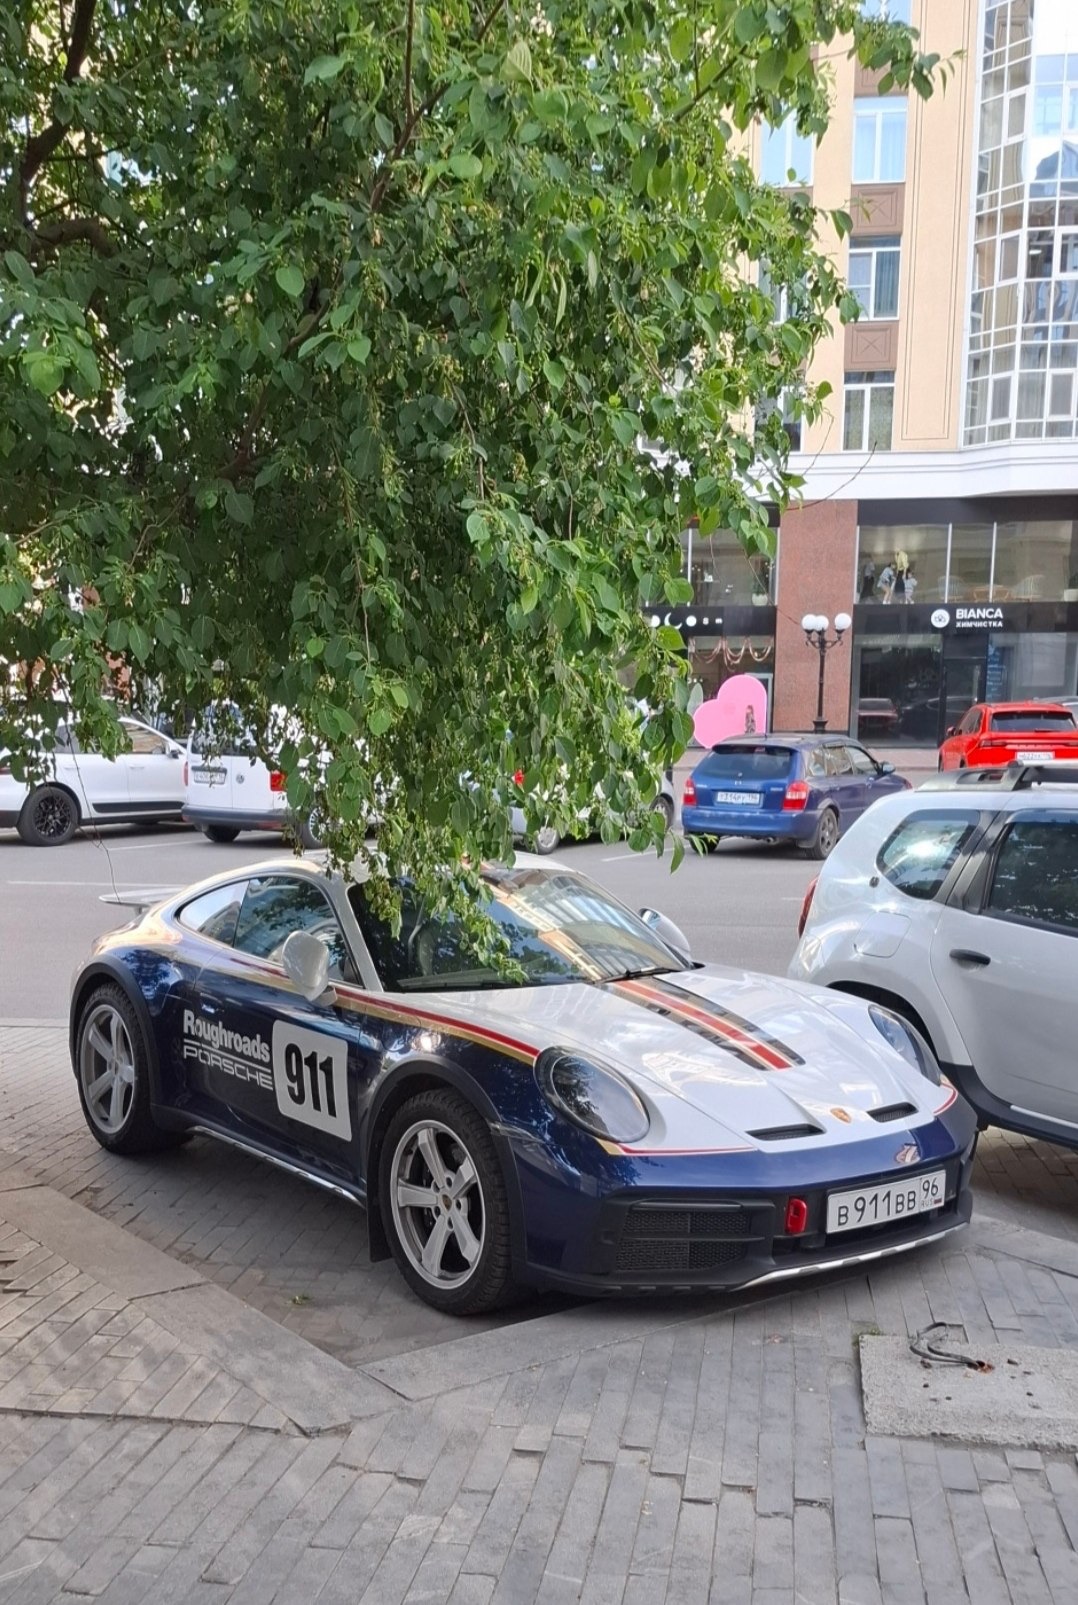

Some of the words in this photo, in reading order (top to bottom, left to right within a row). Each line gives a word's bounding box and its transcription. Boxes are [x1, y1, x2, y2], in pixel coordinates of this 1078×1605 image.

[956, 608, 1003, 619] BIANCA
[183, 1009, 271, 1063] Roughroads
[183, 1045, 274, 1091] PORSCHE
[285, 1043, 337, 1118] 911
[922, 1177, 939, 1199] 96
